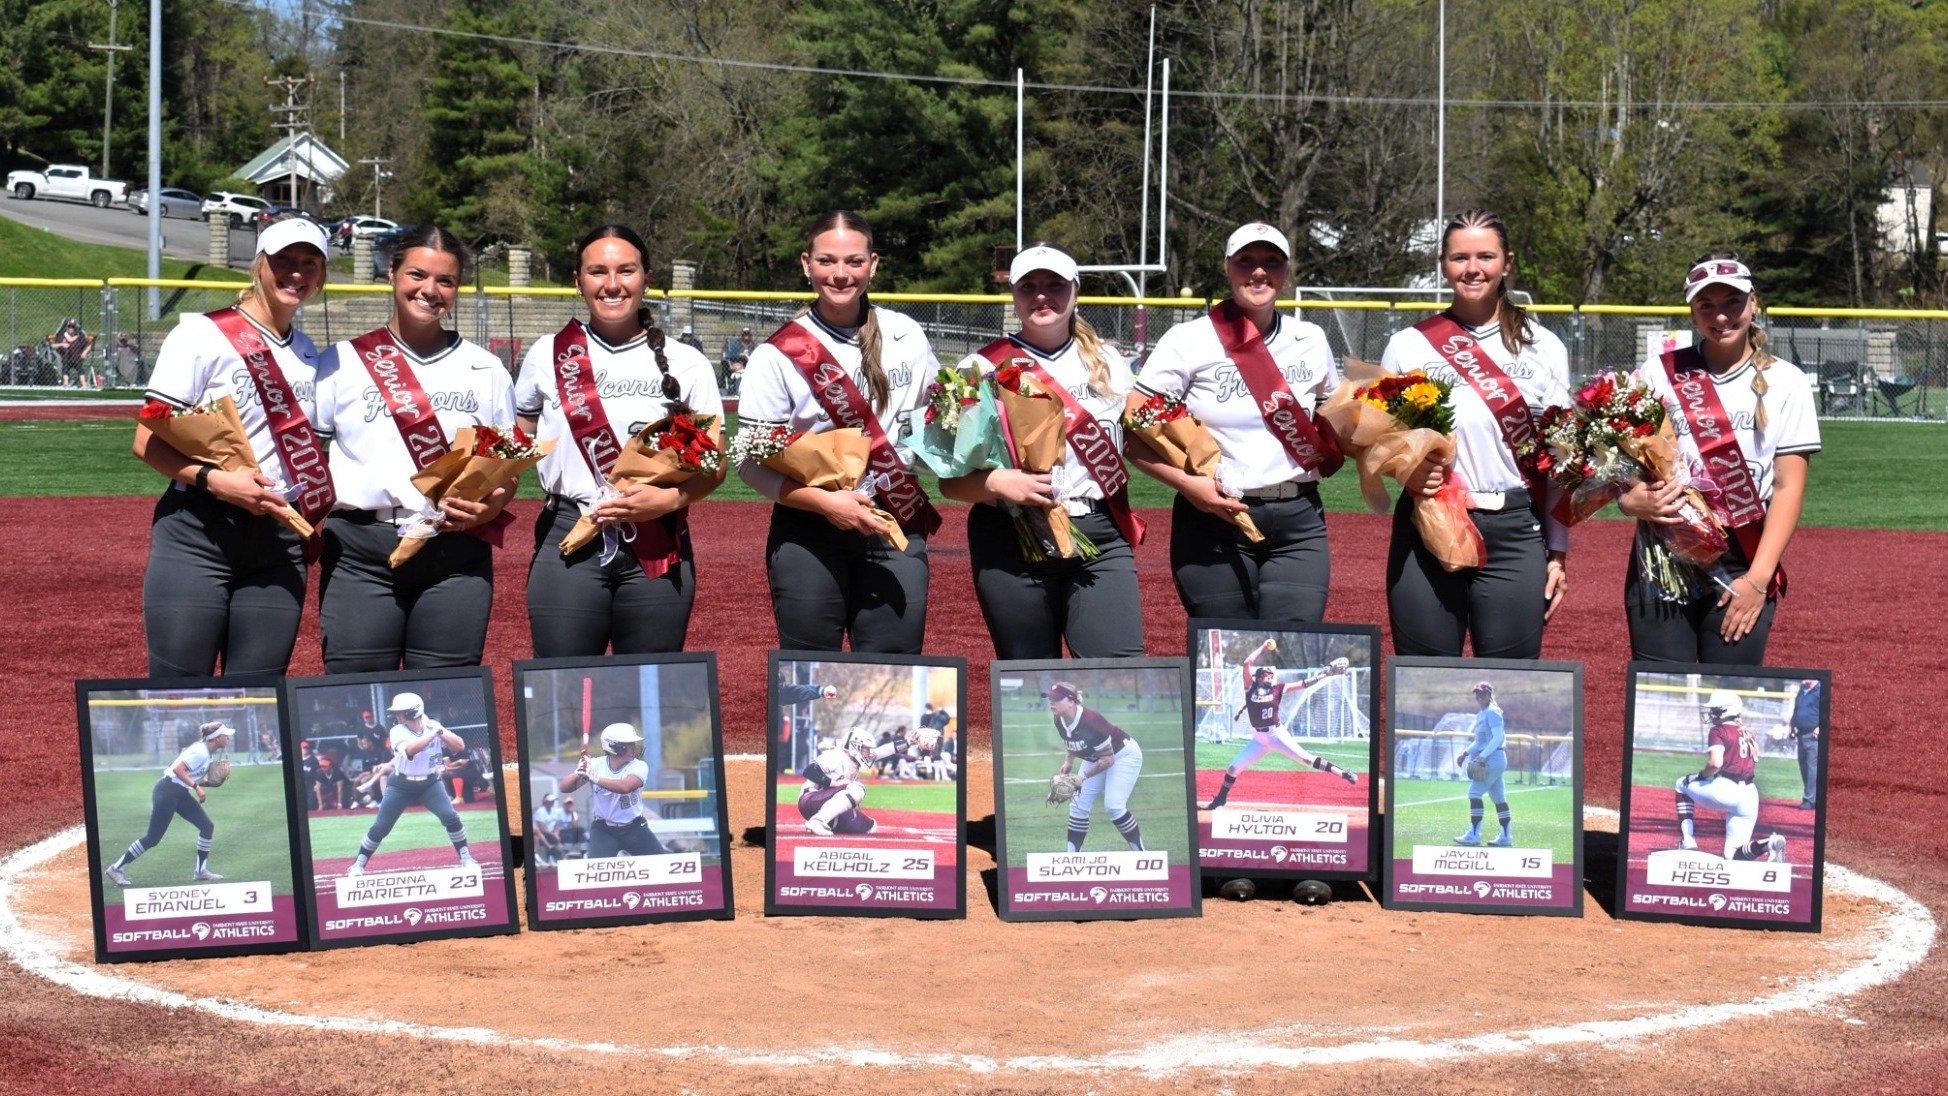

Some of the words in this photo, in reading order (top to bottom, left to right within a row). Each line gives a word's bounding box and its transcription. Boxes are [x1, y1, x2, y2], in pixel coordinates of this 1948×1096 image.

[558, 344, 592, 422] Senior
[1442, 335, 1509, 403] Senior
[1502, 406, 1534, 447] 20
[365, 344, 420, 419] Senior
[408, 425, 446, 468] 20
[234, 332, 291, 419] Senior
[281, 426, 332, 510] 2026
[1263, 390, 1325, 465] Senior
[1072, 422, 1127, 496] 2026
[1241, 814, 1284, 823] OLIVIA
[1228, 824, 1297, 836] HYLTON
[1315, 821, 1343, 834] 20
[819, 851, 874, 861] ABIGAIL
[1052, 857, 1086, 865] KAMI
[1089, 856, 1107, 864] JO
[1199, 848, 1269, 860] SOFTBALL
[1289, 853, 1347, 864] ATHLETICS
[1440, 850, 1489, 859] JAYLIN
[586, 860, 636, 871] KENSY
[803, 861, 891, 873] KEILHOLZ
[902, 858, 930, 871] 25
[1039, 865, 1121, 877] SLAYTON
[1135, 859, 1163, 871] 00
[1521, 857, 1541, 869] 15
[1678, 861, 1725, 871] BELLA
[574, 869, 650, 884] THOMAS
[668, 861, 696, 875] 28
[1671, 870, 1731, 886] HESS
[1762, 870, 1777, 883] 8
[347, 884, 438, 902] MARIETTA
[449, 875, 478, 889] 23
[356, 874, 427, 889] BREONNA
[148, 889, 211, 901] SYDNEY
[780, 887, 854, 898] SOFTBALL
[874, 891, 934, 902] ATHLETICS
[1014, 892, 1088, 902] SOFTBALL
[1109, 892, 1170, 903] ATHLETICS
[1399, 884, 1472, 895] SOFTBALL
[1492, 888, 1552, 900] ATHLETICS
[135, 899, 226, 914] EMANUEL
[243, 891, 258, 904] 3
[545, 898, 622, 912] SOFTBALL
[642, 894, 704, 908] ATHLETICS
[1632, 894, 1707, 907] SOFTBALL
[1727, 901, 1790, 915] ATHLETICS
[325, 915, 403, 931] SOFTBALL
[424, 908, 487, 924] ATHLETICS
[112, 929, 191, 943] SOFTBALL
[212, 925, 275, 939] ATHLETICS
